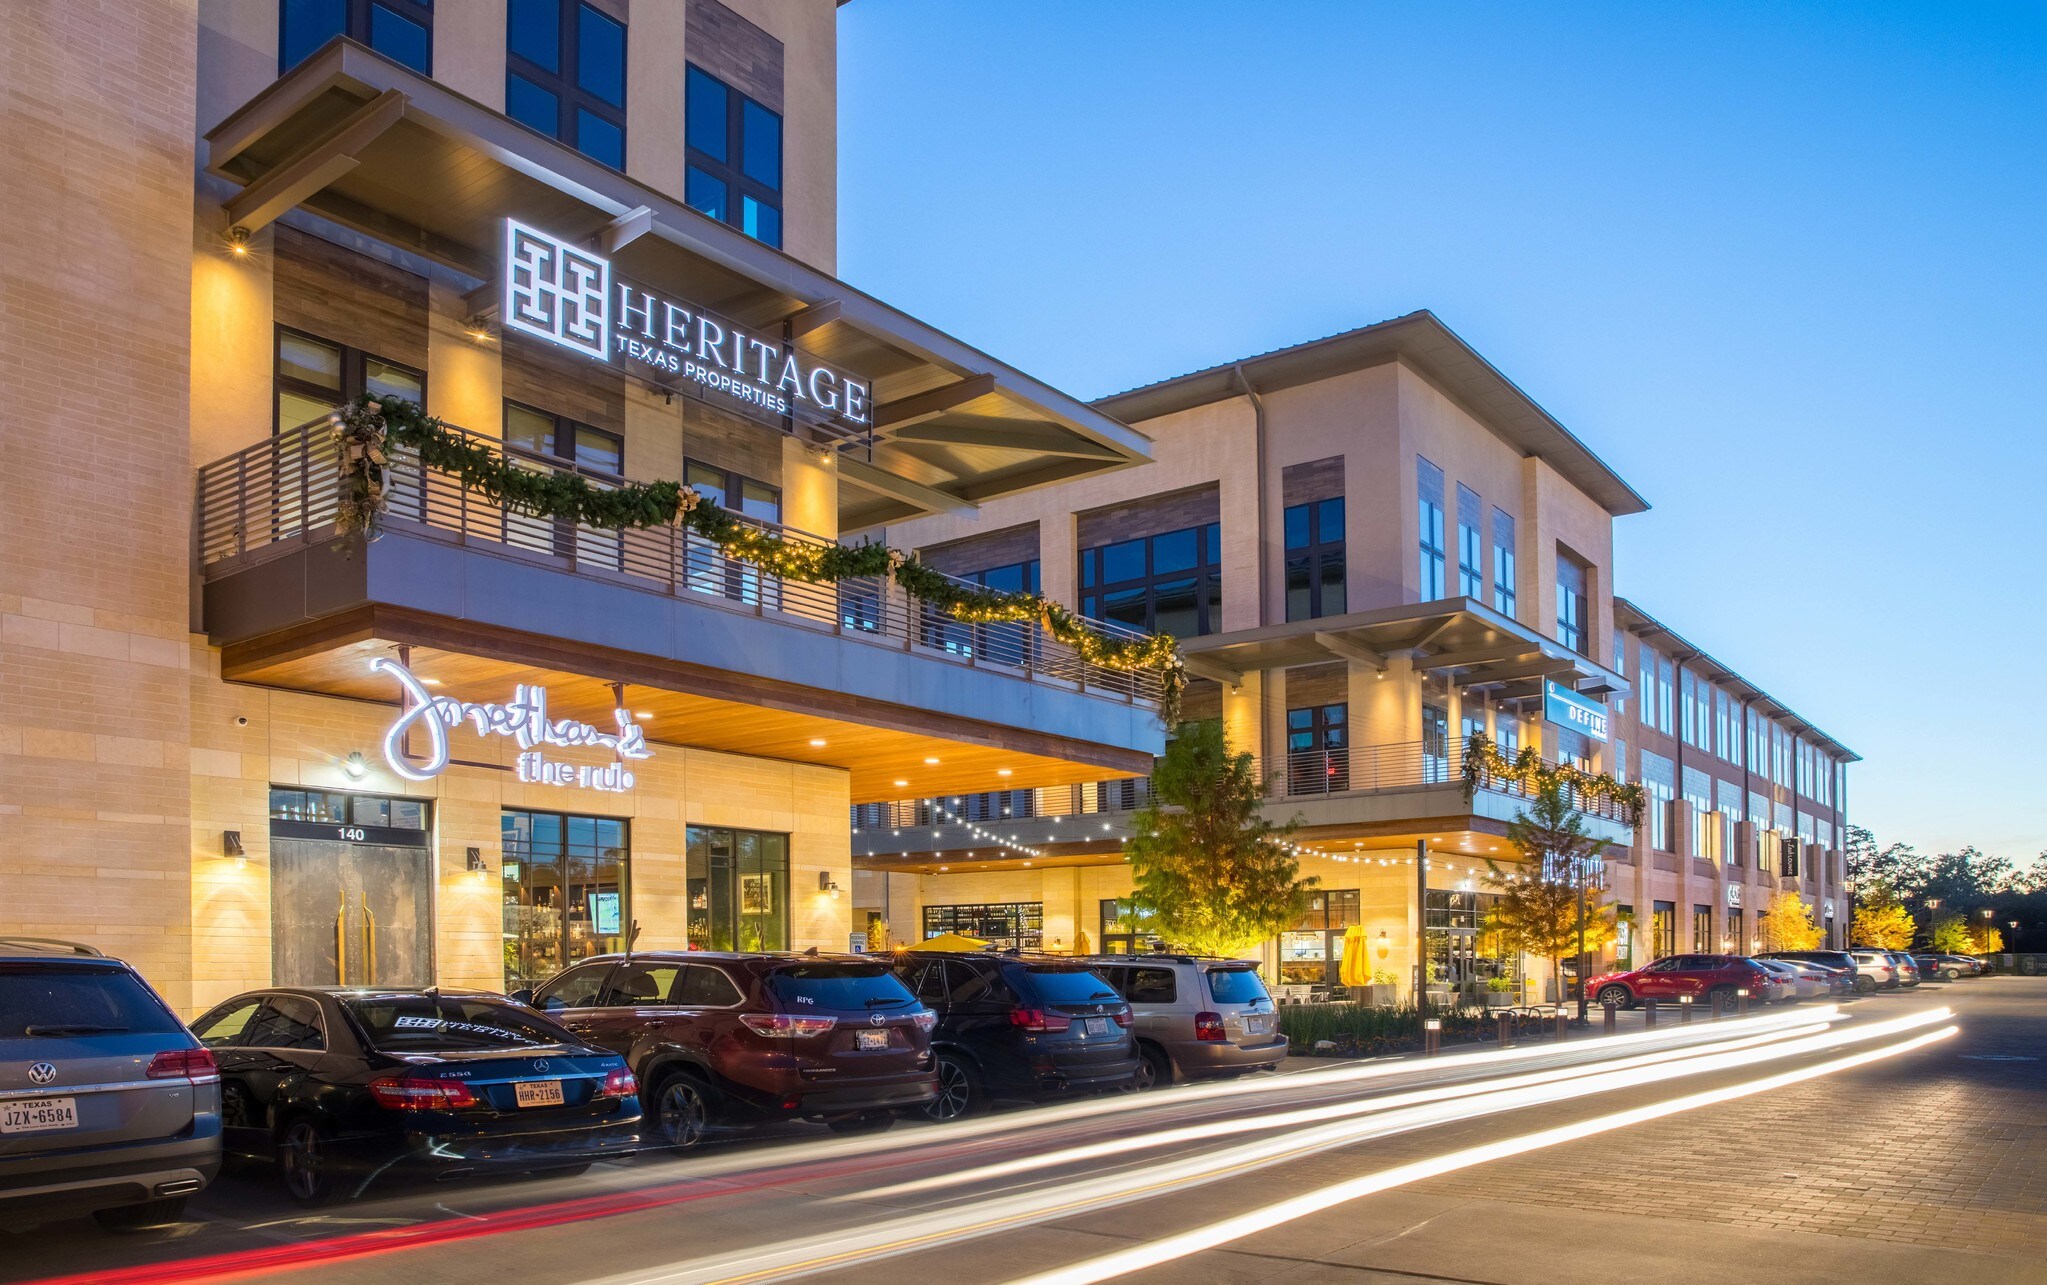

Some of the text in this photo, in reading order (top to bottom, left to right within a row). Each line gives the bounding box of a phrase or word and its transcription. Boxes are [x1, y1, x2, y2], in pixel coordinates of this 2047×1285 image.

[616, 281, 866, 423] HERITAGE
[616, 334, 787, 413] TEXAS PROPERTIES
[1569, 705, 1607, 733] DEFINE
[516, 751, 636, 793] the rub
[338, 828, 365, 841] 140
[797, 996, 814, 1005] RPG
[22, 1100, 53, 1109] TEXAS
